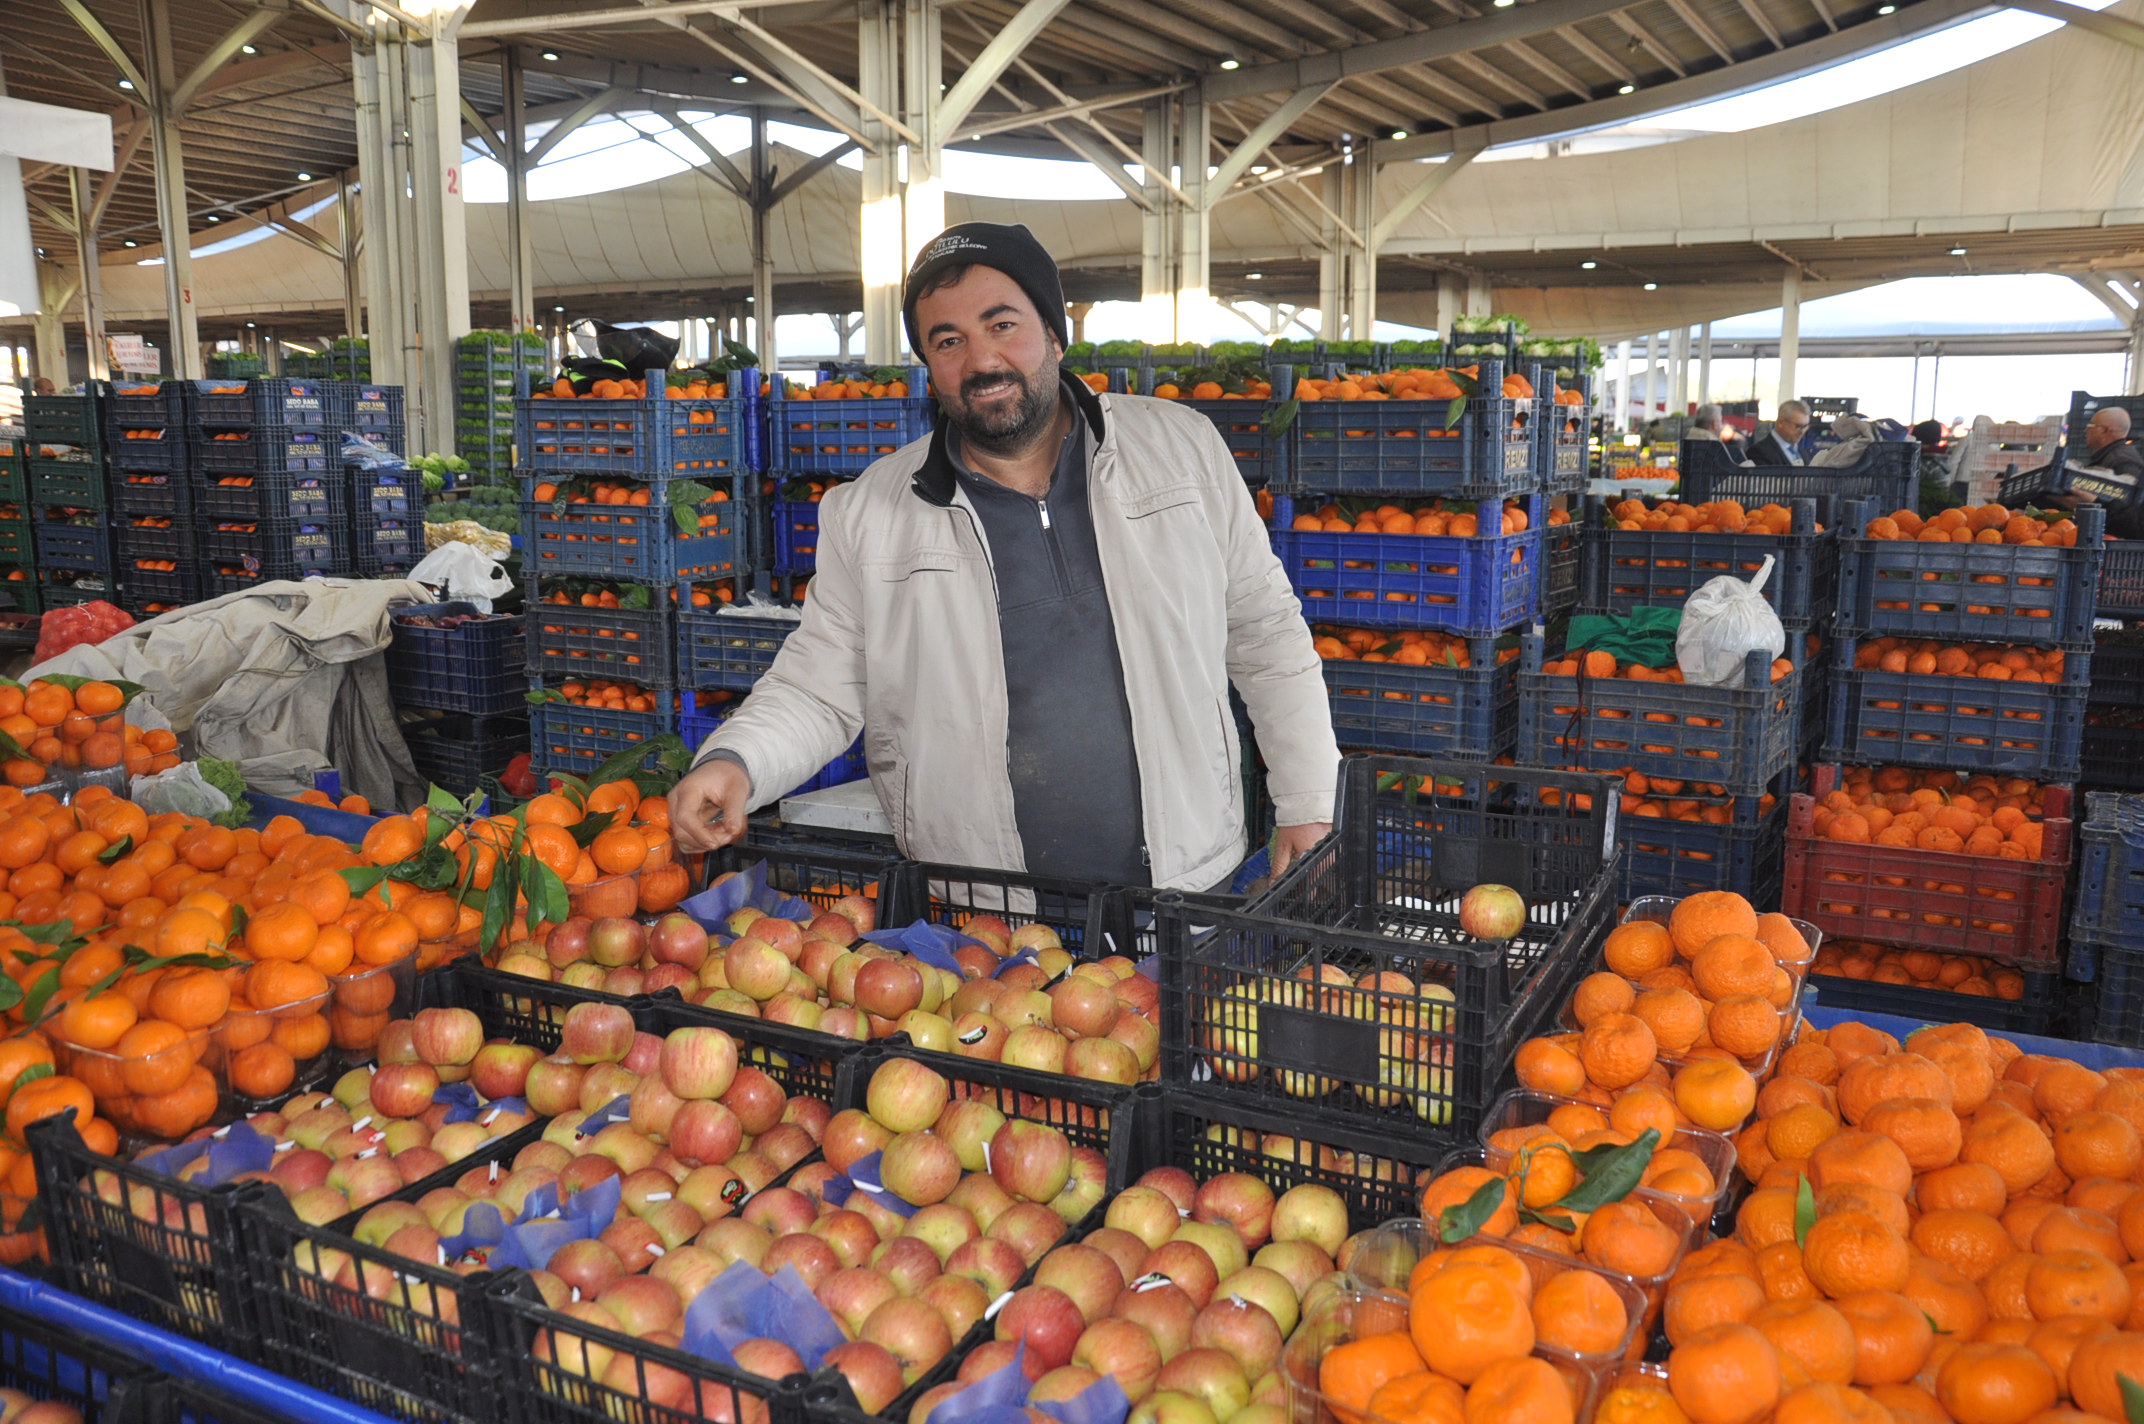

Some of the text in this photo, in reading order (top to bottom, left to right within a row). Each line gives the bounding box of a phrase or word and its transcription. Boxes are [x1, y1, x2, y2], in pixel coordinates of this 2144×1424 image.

[447, 168, 458, 194] 2
[183, 289, 191, 304] 3
[308, 489, 325, 497] BABA
[311, 534, 327, 542] BABA
